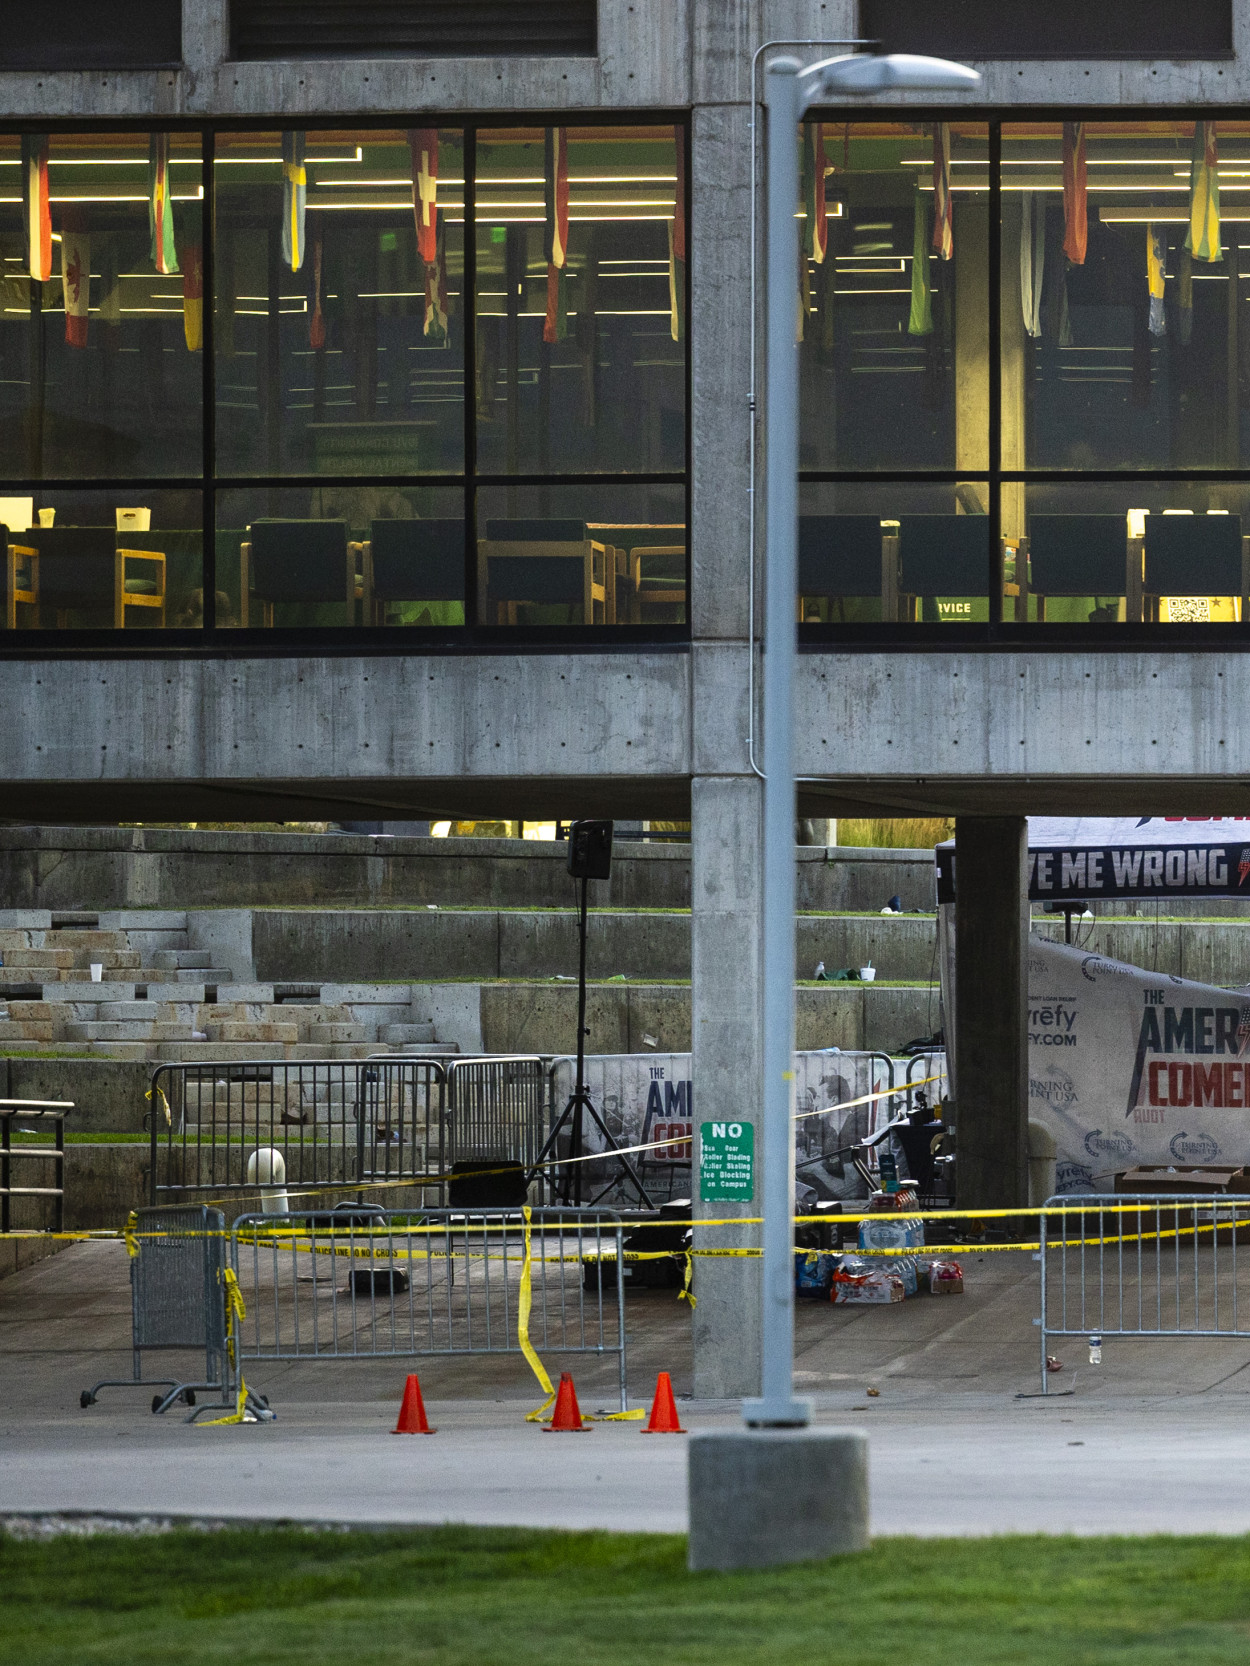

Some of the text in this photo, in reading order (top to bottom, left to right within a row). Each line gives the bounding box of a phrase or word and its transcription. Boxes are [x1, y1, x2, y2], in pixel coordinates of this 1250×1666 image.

[1062, 851, 1104, 889] ME
[1111, 849, 1228, 888] WRONG
[1143, 989, 1165, 1004] THE
[1028, 1004, 1077, 1032] rēfy
[1028, 1033, 1077, 1046] FY.COM
[649, 1067, 665, 1079] THE
[1030, 1080, 1073, 1091] RNING
[712, 1123, 743, 1138] NO
[726, 1154, 751, 1162] Blading
[719, 1171, 751, 1180] Blocking
[720, 1181, 747, 1189] Campus
[376, 1249, 398, 1258] CROS
